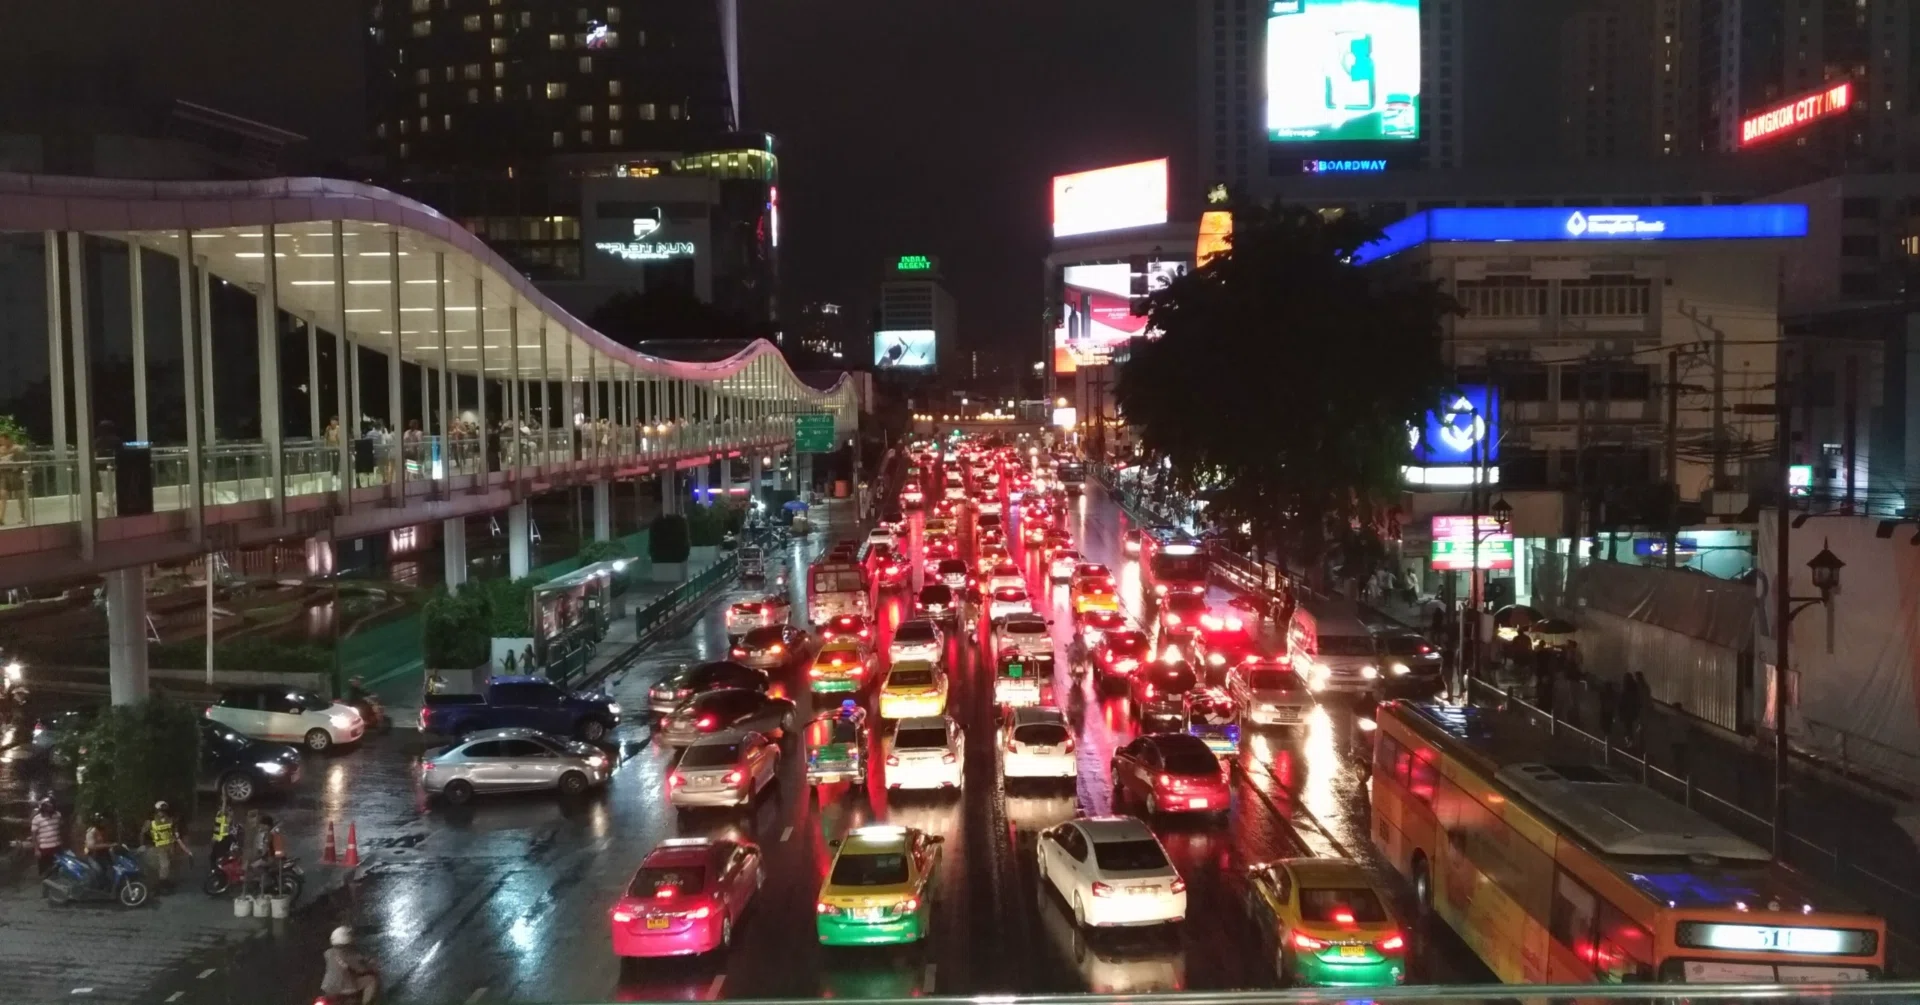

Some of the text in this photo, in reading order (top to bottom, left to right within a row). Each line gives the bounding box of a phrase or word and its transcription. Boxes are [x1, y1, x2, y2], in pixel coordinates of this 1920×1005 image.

[1743, 84, 1847, 141] BANGKOK CITY INN
[1318, 159, 1387, 171] BOARDWAY
